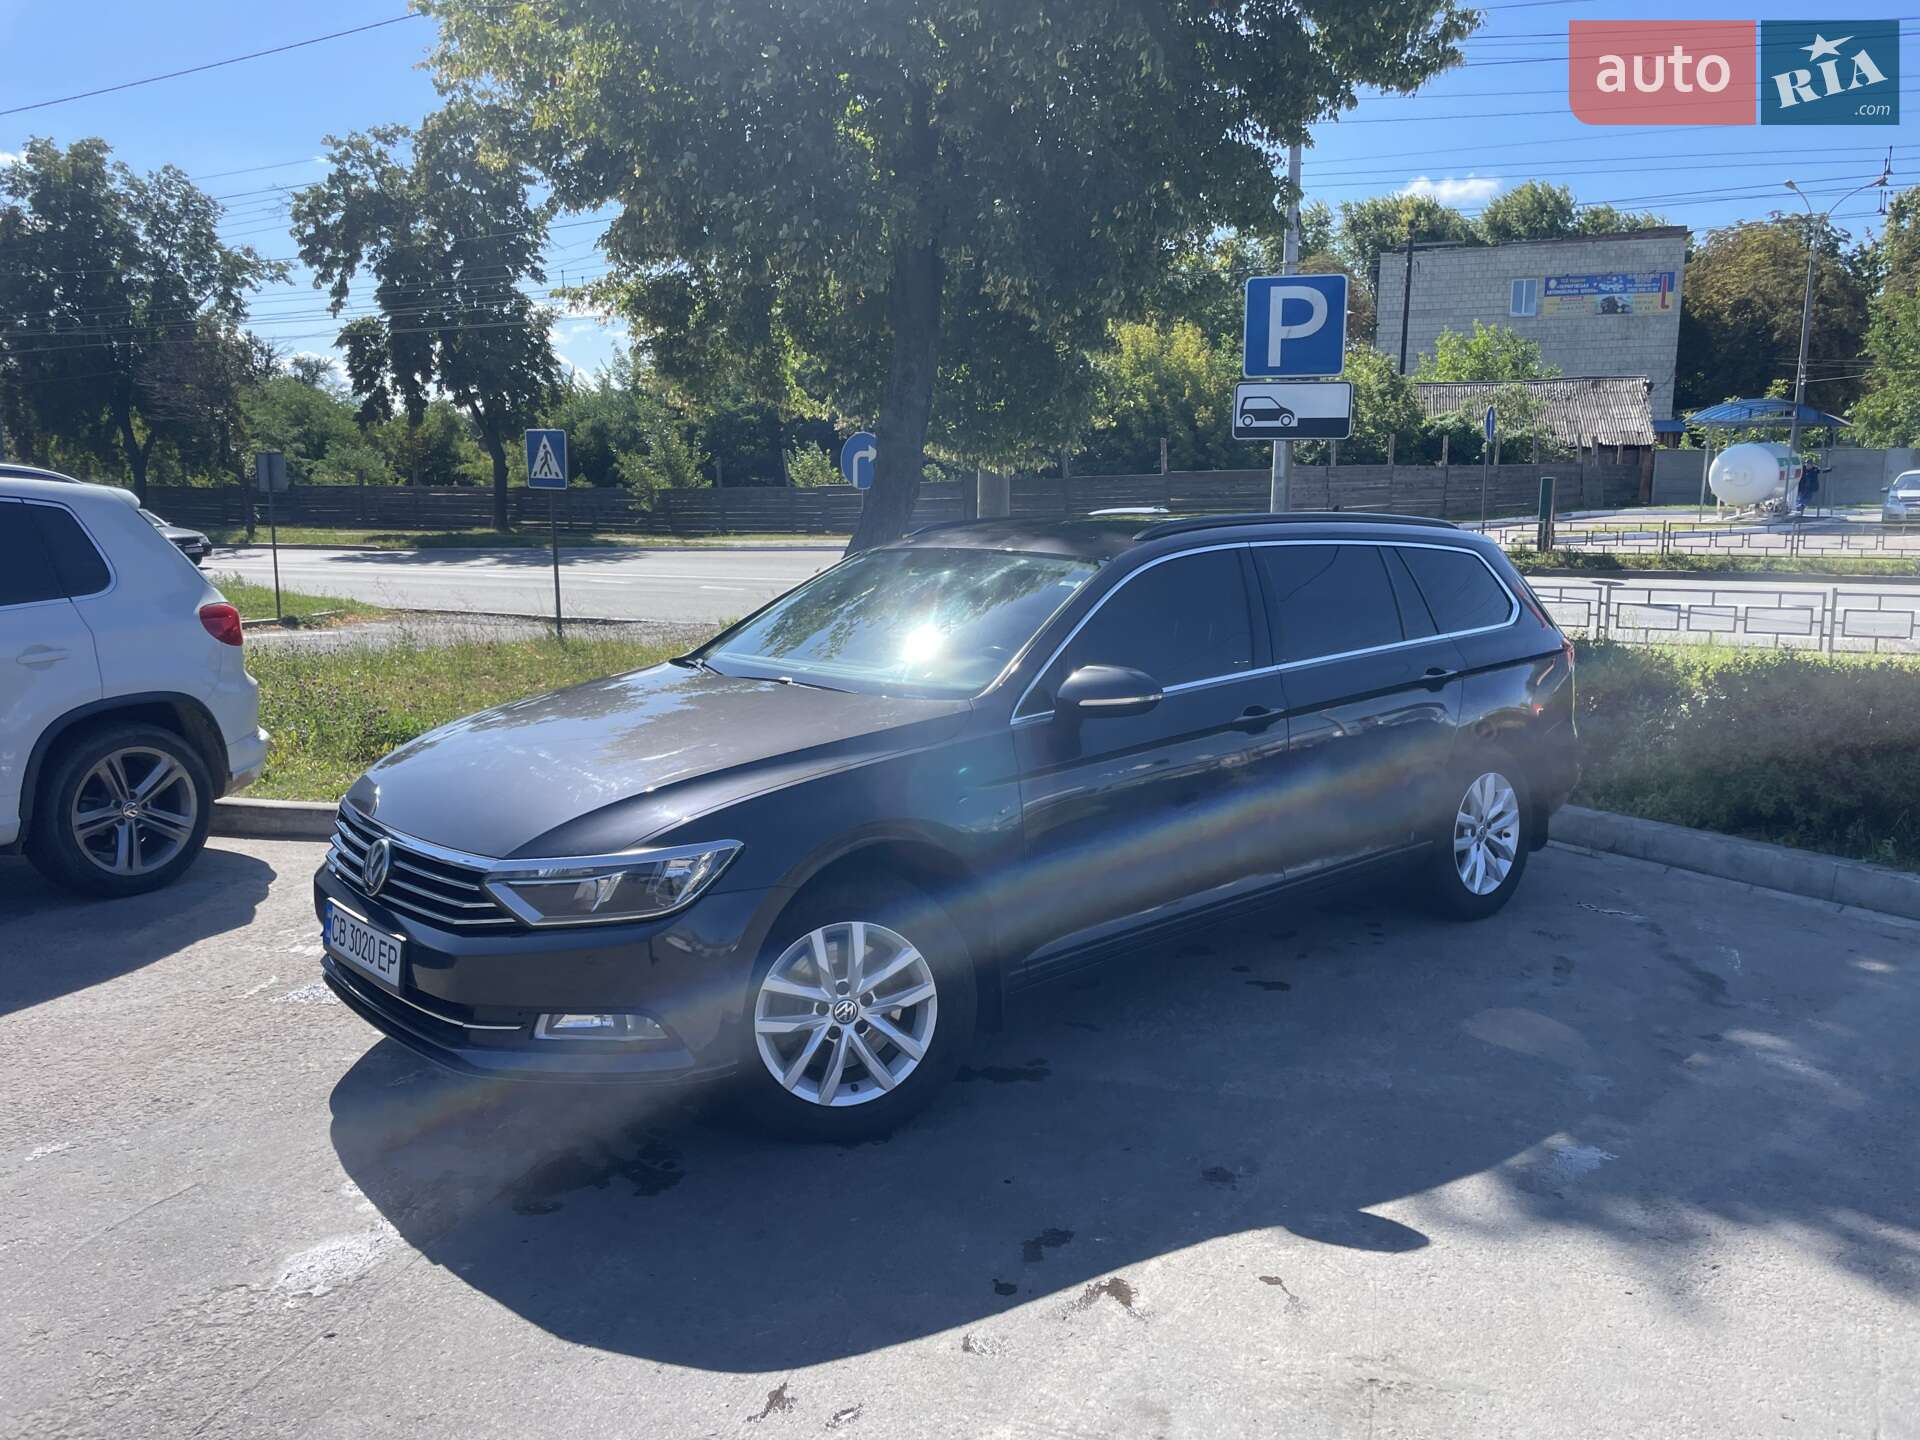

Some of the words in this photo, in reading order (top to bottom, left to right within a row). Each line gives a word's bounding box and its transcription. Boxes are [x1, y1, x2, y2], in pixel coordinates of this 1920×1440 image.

[1267, 285, 1328, 368] P
[332, 915, 346, 946] CB
[348, 923, 376, 964] 3020
[378, 941, 397, 974] EP
